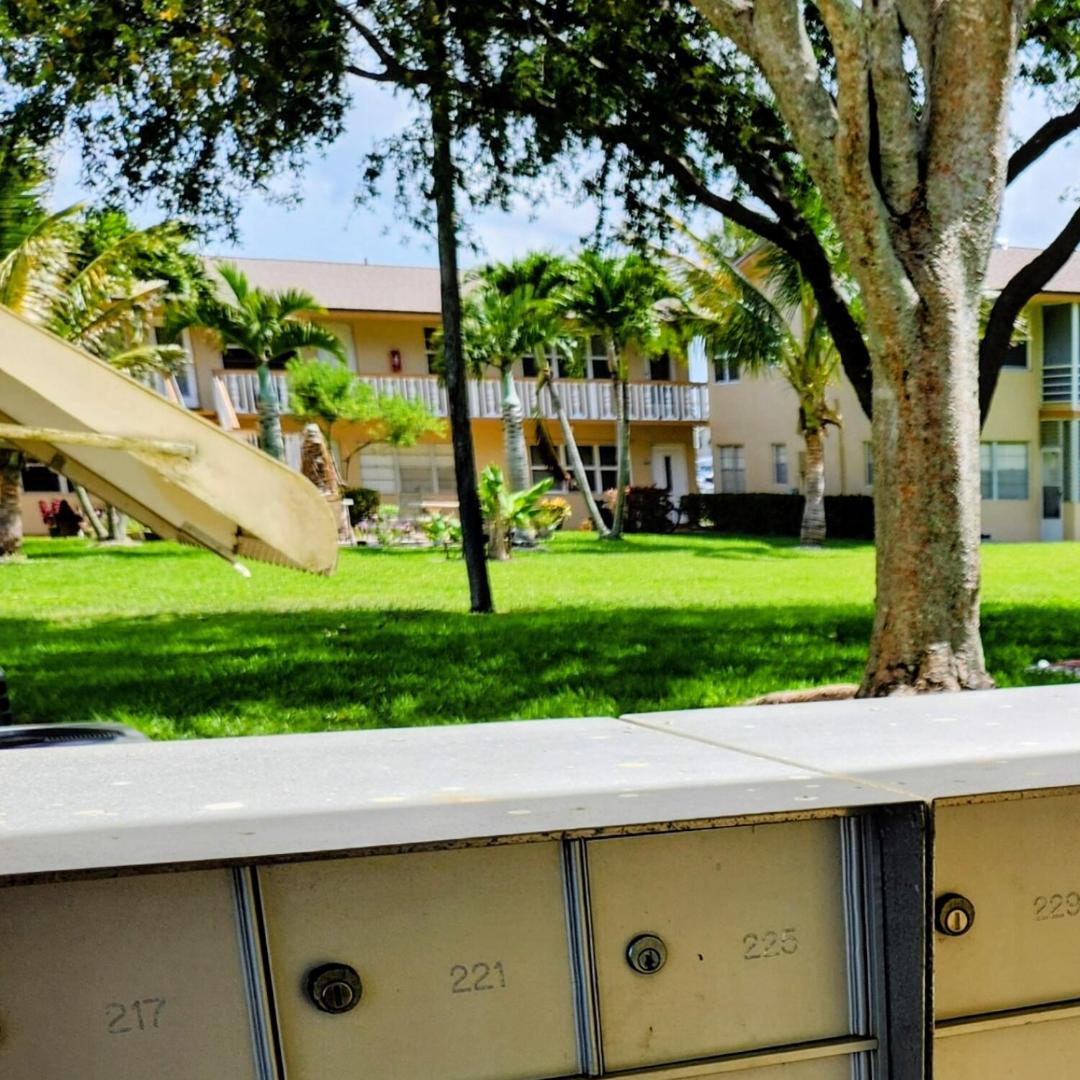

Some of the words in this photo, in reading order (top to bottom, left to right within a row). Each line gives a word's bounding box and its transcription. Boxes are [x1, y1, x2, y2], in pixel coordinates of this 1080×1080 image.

[742, 927, 799, 960] 225
[449, 960, 507, 994] 221
[105, 997, 167, 1034] 217
